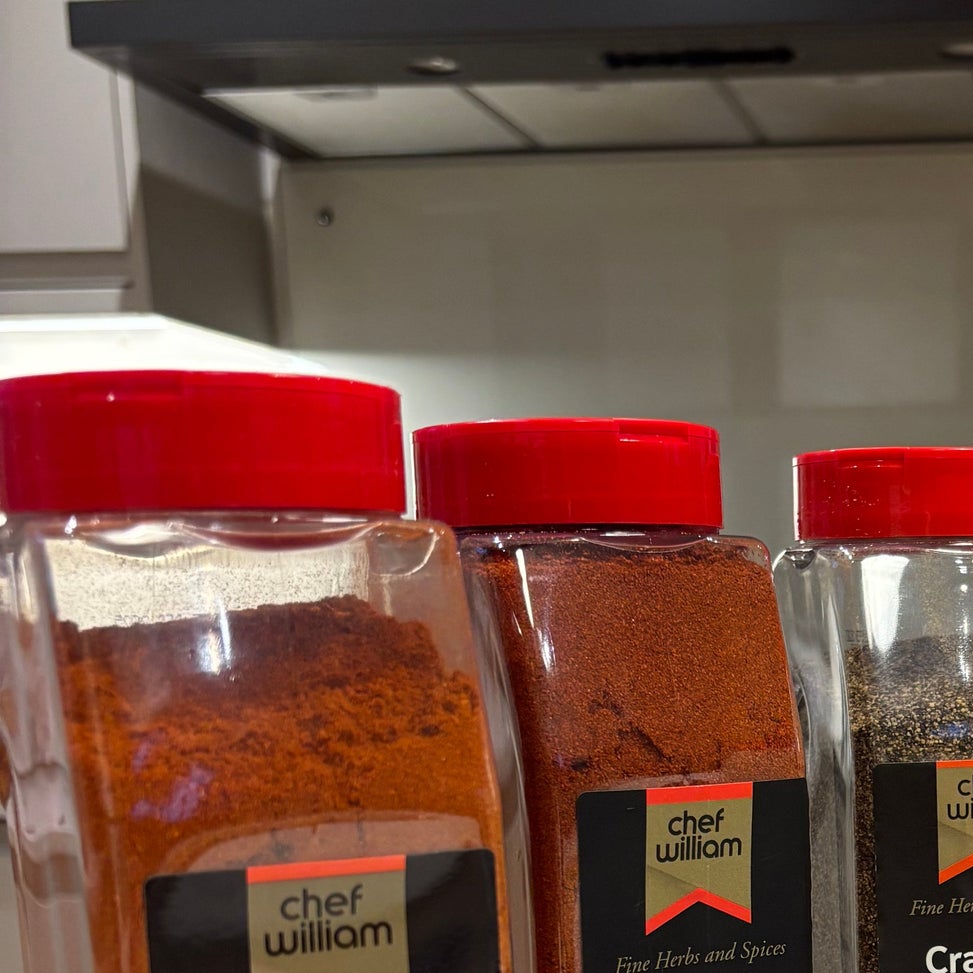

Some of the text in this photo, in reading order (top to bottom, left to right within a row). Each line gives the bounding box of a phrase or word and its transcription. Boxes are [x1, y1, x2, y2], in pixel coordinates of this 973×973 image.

[668, 808, 724, 836] chef
[656, 837, 742, 863] william
[280, 884, 363, 922] chef
[910, 900, 944, 916] Fine
[264, 920, 392, 957] william
[655, 947, 700, 970] Herbs
[705, 942, 735, 963] and
[740, 940, 786, 964] Spices
